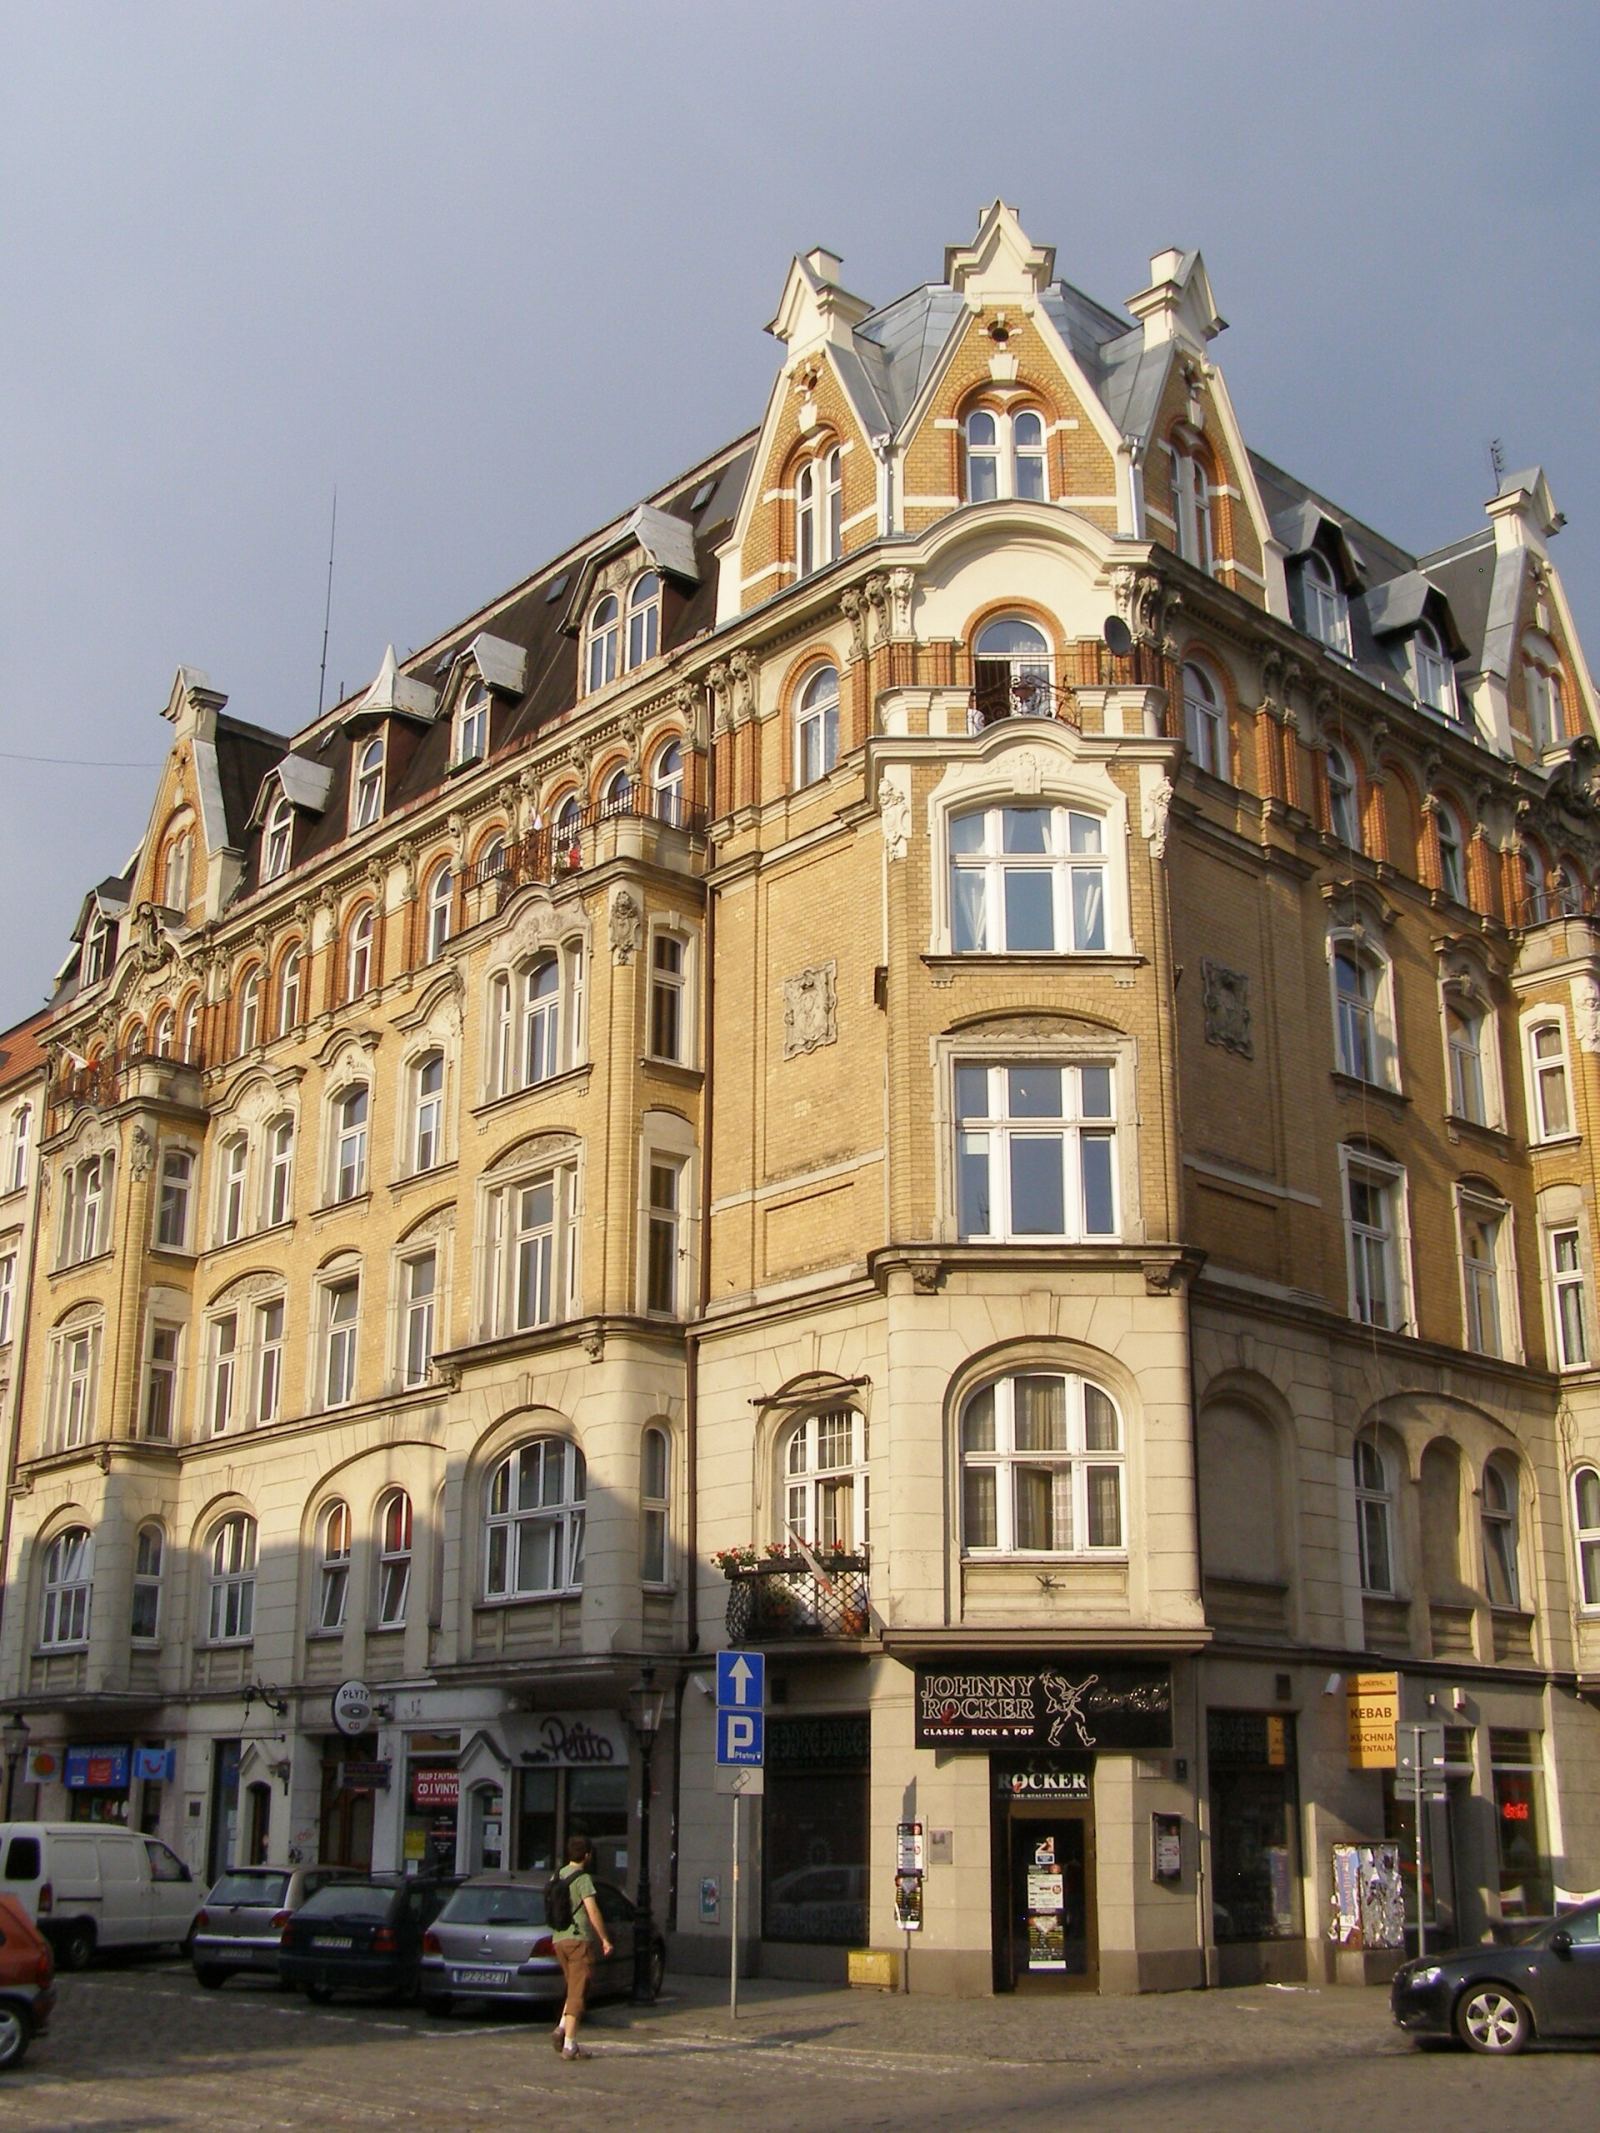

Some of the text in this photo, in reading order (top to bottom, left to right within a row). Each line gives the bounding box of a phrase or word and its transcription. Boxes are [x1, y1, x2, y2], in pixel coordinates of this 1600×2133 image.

[921, 1676, 1035, 1698] JOHNNY
[343, 1690, 369, 1700] PŁYTY
[922, 1698, 1035, 1720] ROCKER
[1350, 1707, 1393, 1719] KEBAB
[728, 1716, 753, 1758] P
[1350, 1733, 1394, 1742] KUCHNIA
[998, 1773, 1087, 1789] ROCKER
[418, 1783, 429, 1794] CD
